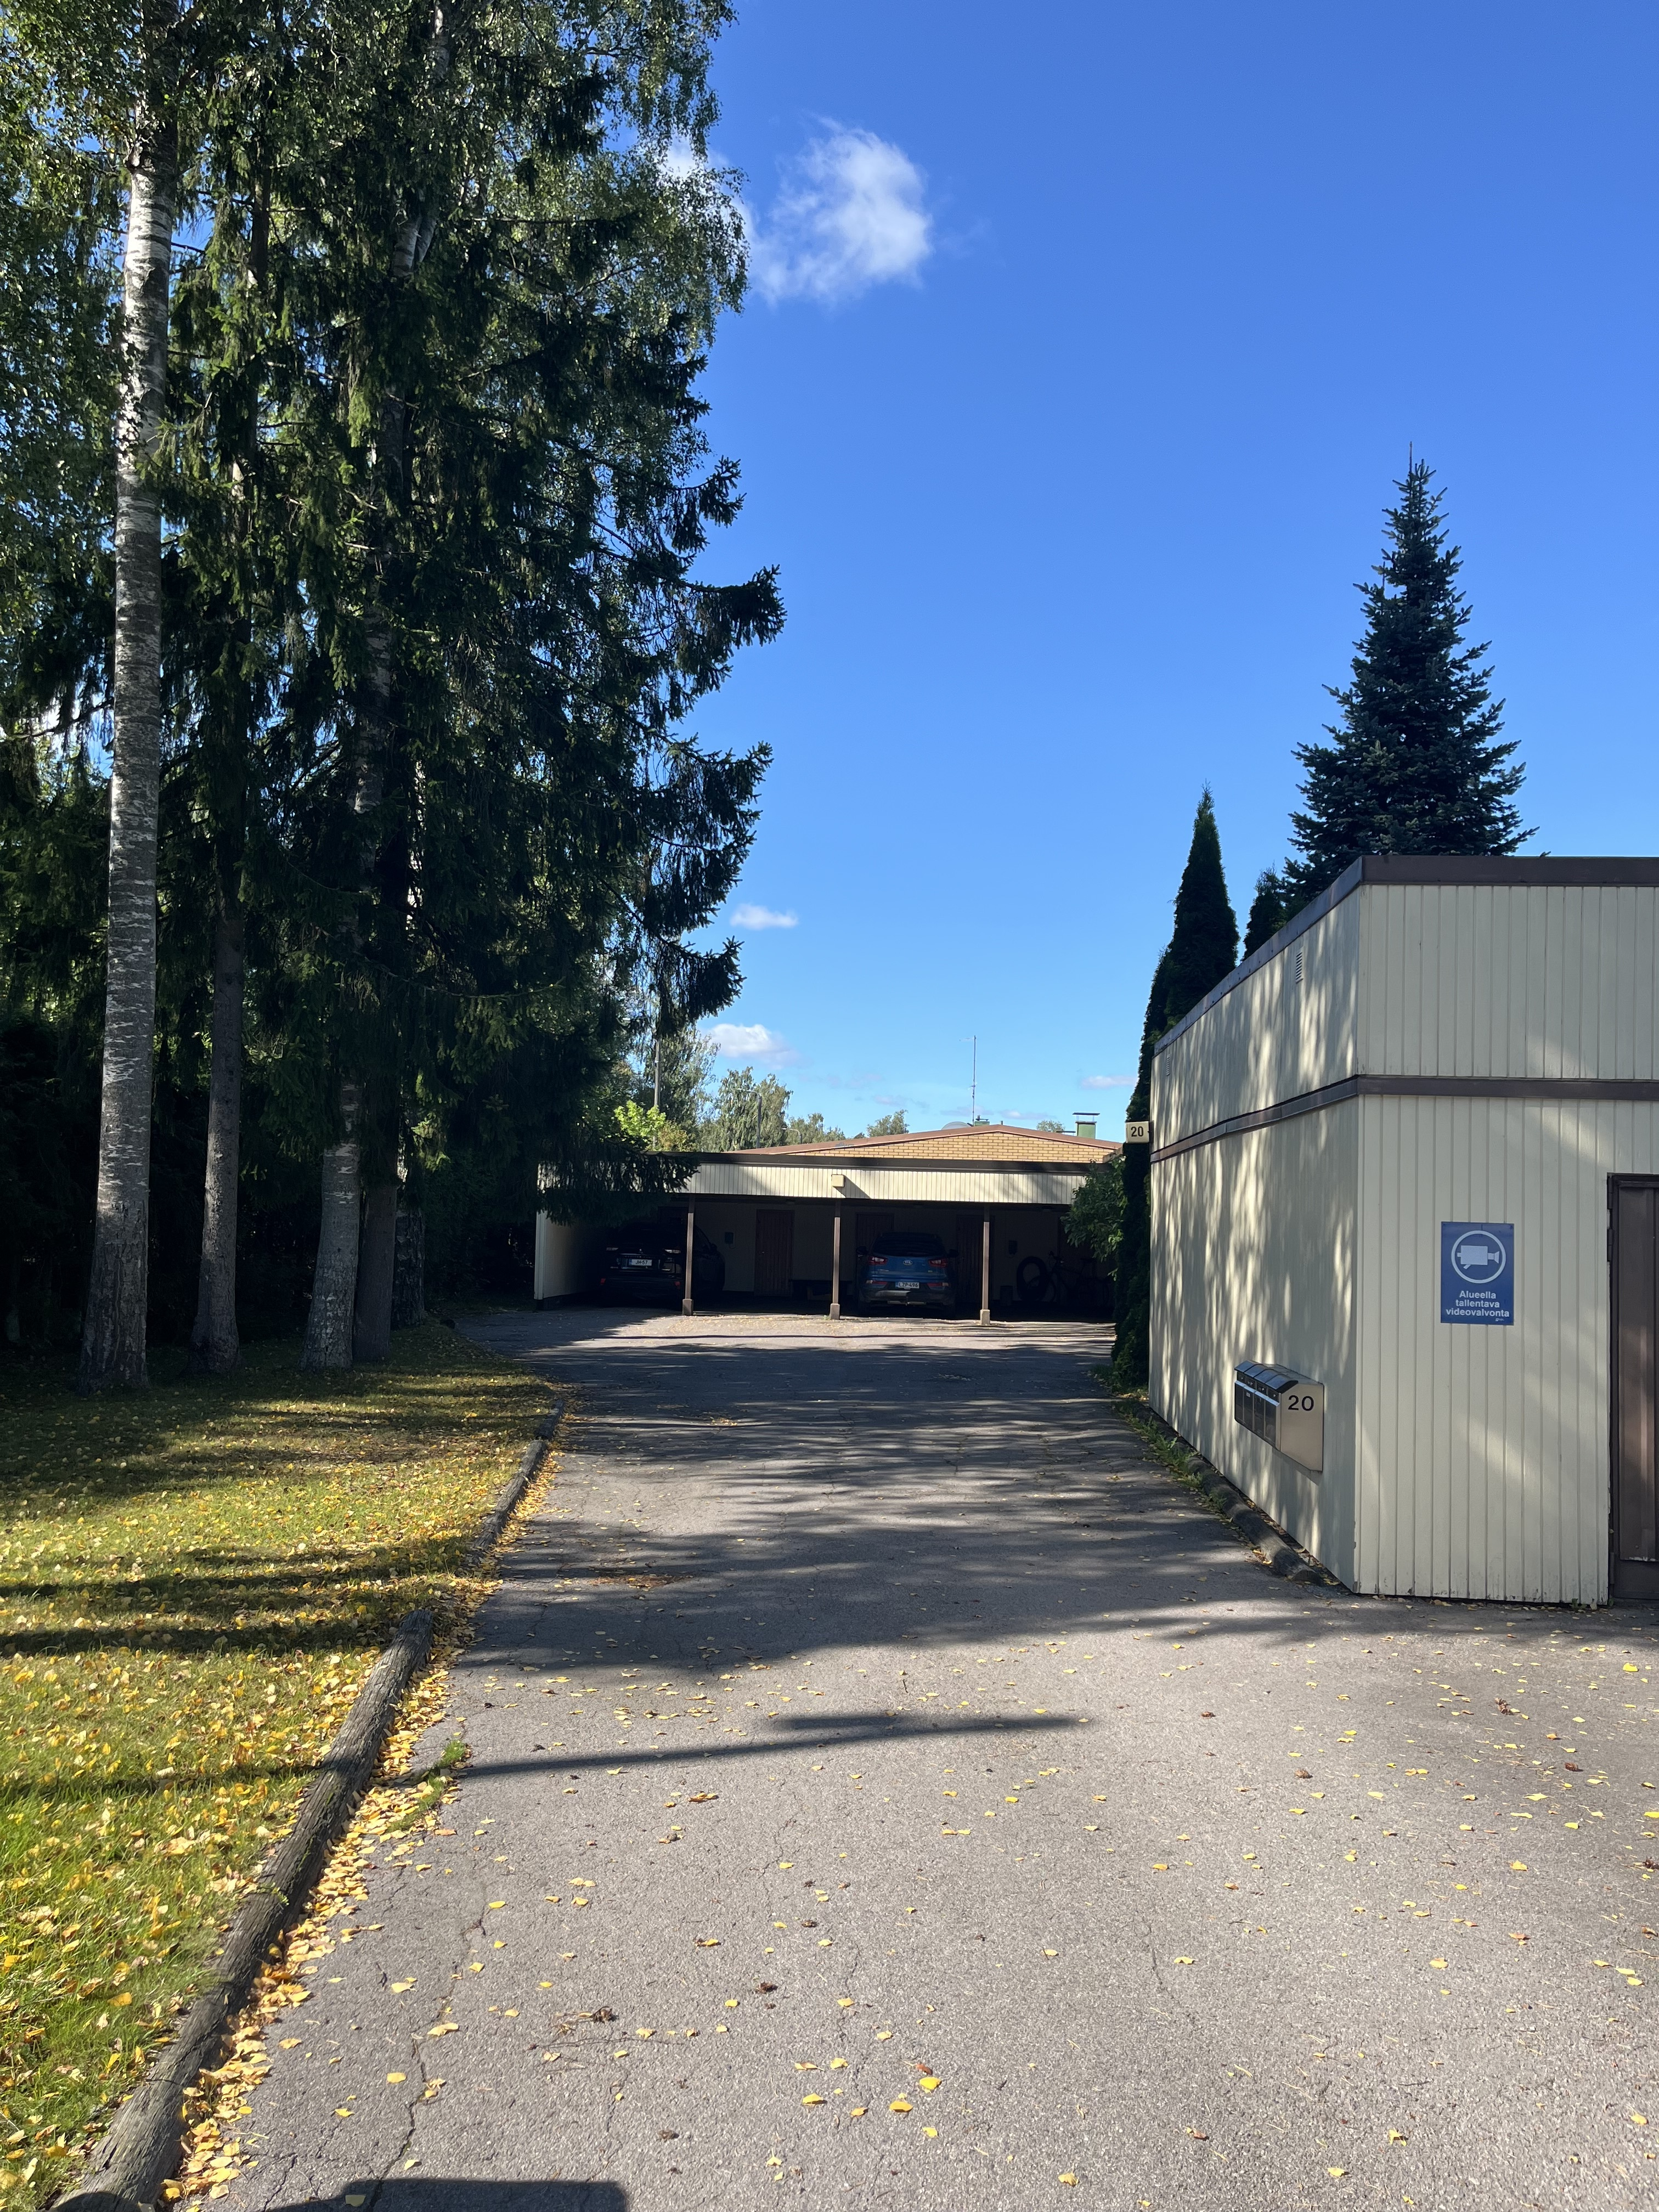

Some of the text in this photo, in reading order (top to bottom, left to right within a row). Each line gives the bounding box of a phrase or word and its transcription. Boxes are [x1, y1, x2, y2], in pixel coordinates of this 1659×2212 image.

[1131, 1126, 1144, 1137] 20
[1459, 1290, 1496, 1299] Alueella
[1455, 1299, 1500, 1308] tallentava
[1446, 1308, 1510, 1317] videovalvonta
[1288, 1395, 1314, 1412] 20
